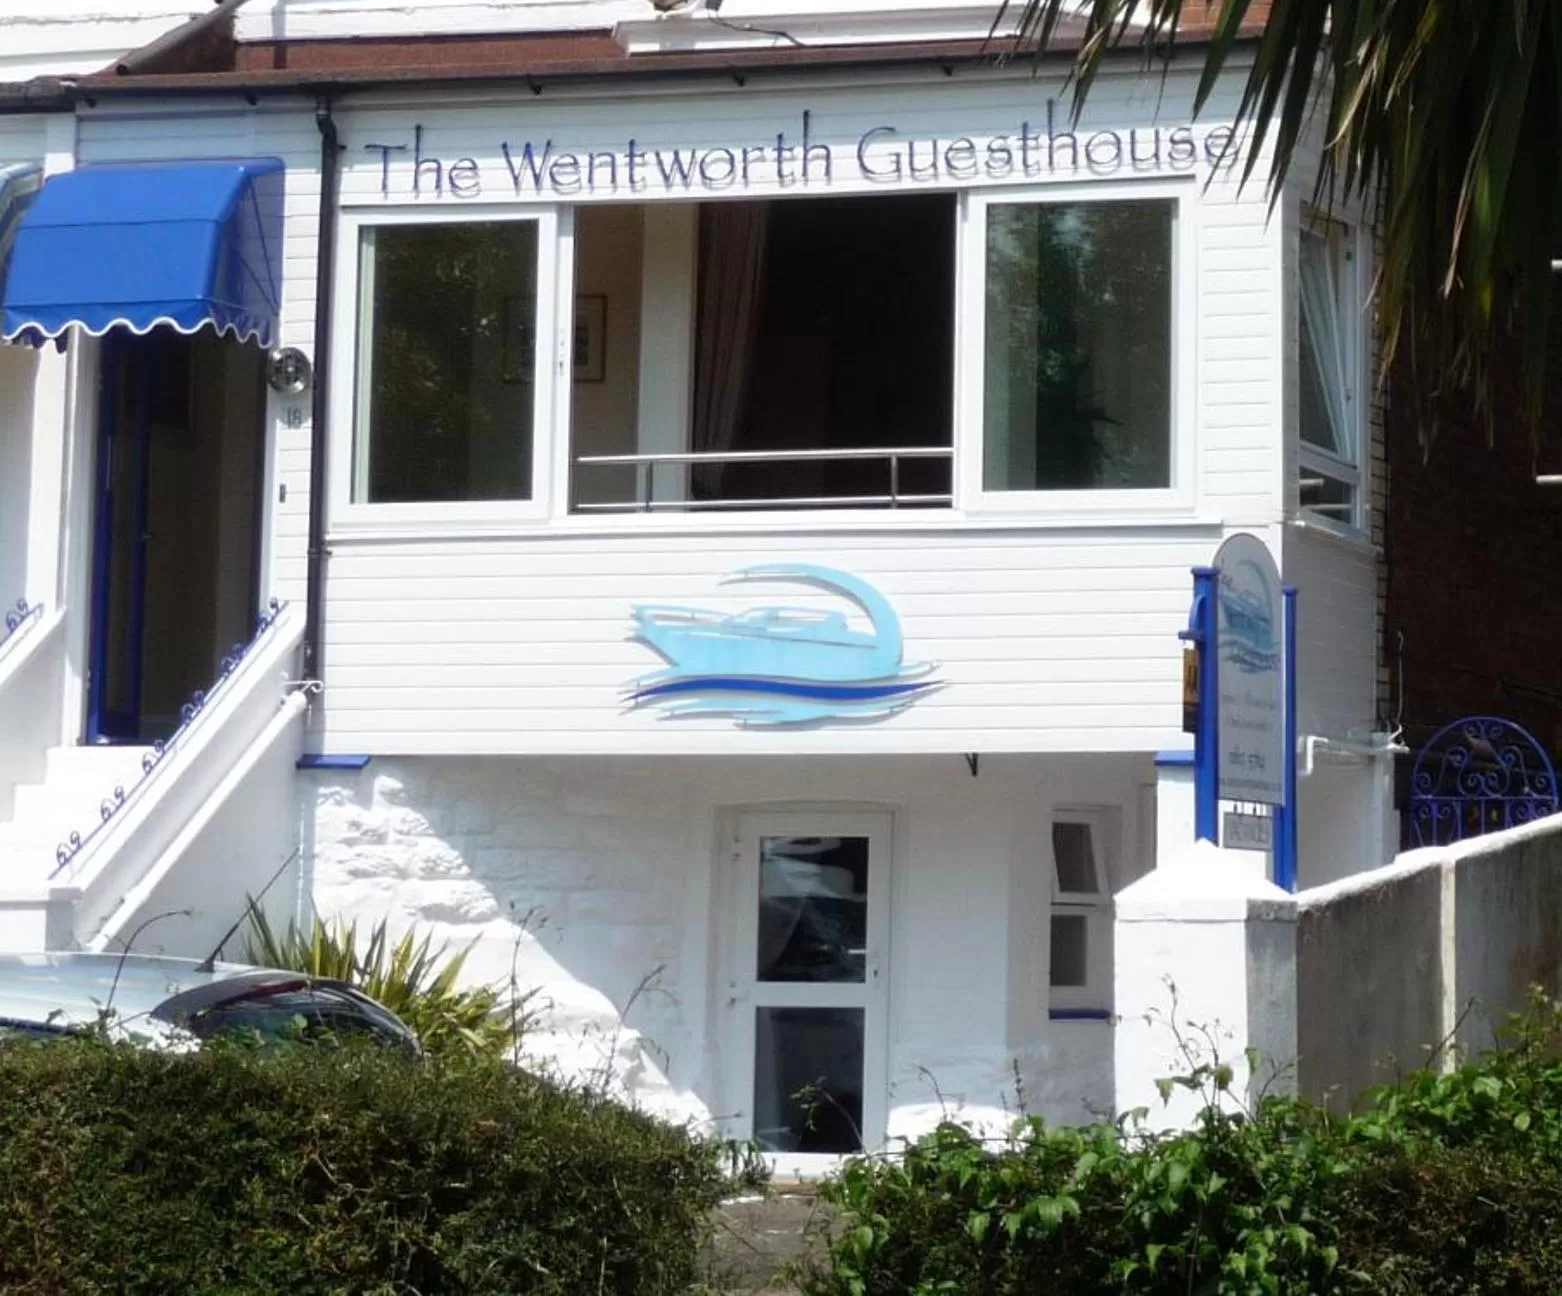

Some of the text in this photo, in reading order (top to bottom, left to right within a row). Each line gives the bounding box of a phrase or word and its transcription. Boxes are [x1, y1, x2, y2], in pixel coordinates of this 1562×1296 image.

[364, 98, 1240, 197] The Wentworth Guesthouse
